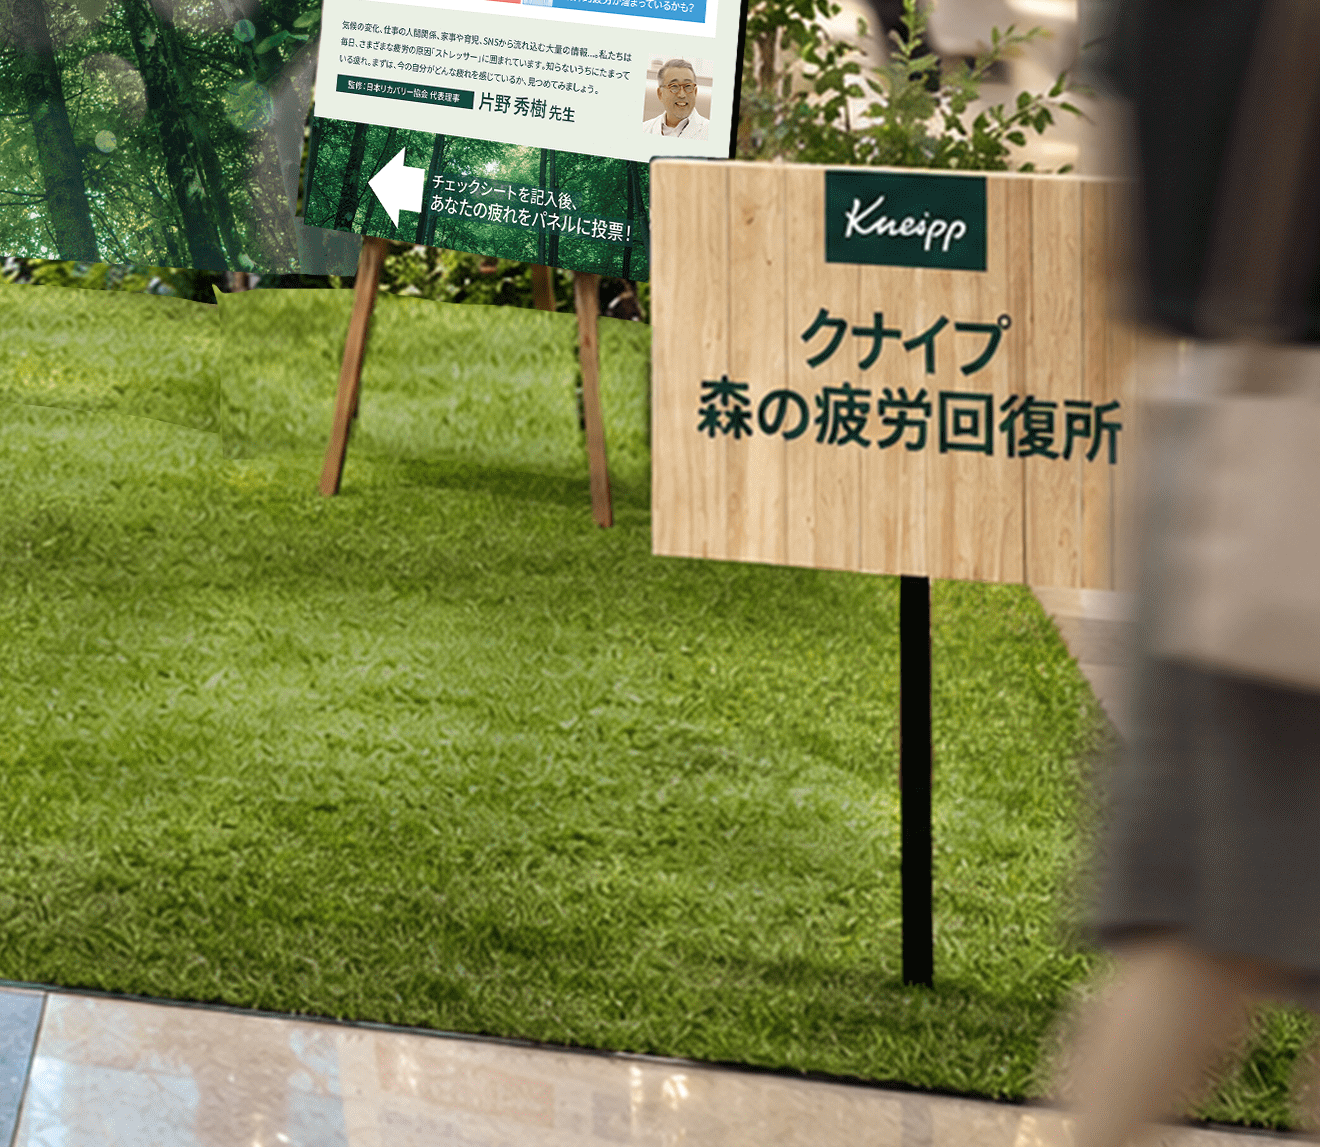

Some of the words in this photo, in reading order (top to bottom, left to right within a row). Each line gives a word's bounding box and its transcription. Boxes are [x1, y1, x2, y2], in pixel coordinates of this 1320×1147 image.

[339, 53, 599, 95] いる疲れ。まずは、今の自分がどんな疲れを感じているか、見つめてみましょう。
[429, 89, 461, 104] 代表理事
[478, 91, 511, 115] 片野
[513, 96, 547, 120] 秀樹
[548, 104, 575, 122] 先生
[430, 193, 632, 242] あなたの疲れをパネルに投票!
[432, 175, 578, 211] チェックシートを記入後、
[844, 195, 967, 252] Kneipp
[801, 308, 1012, 376] クナイプ
[697, 375, 1123, 465] 森の疲労回復所
